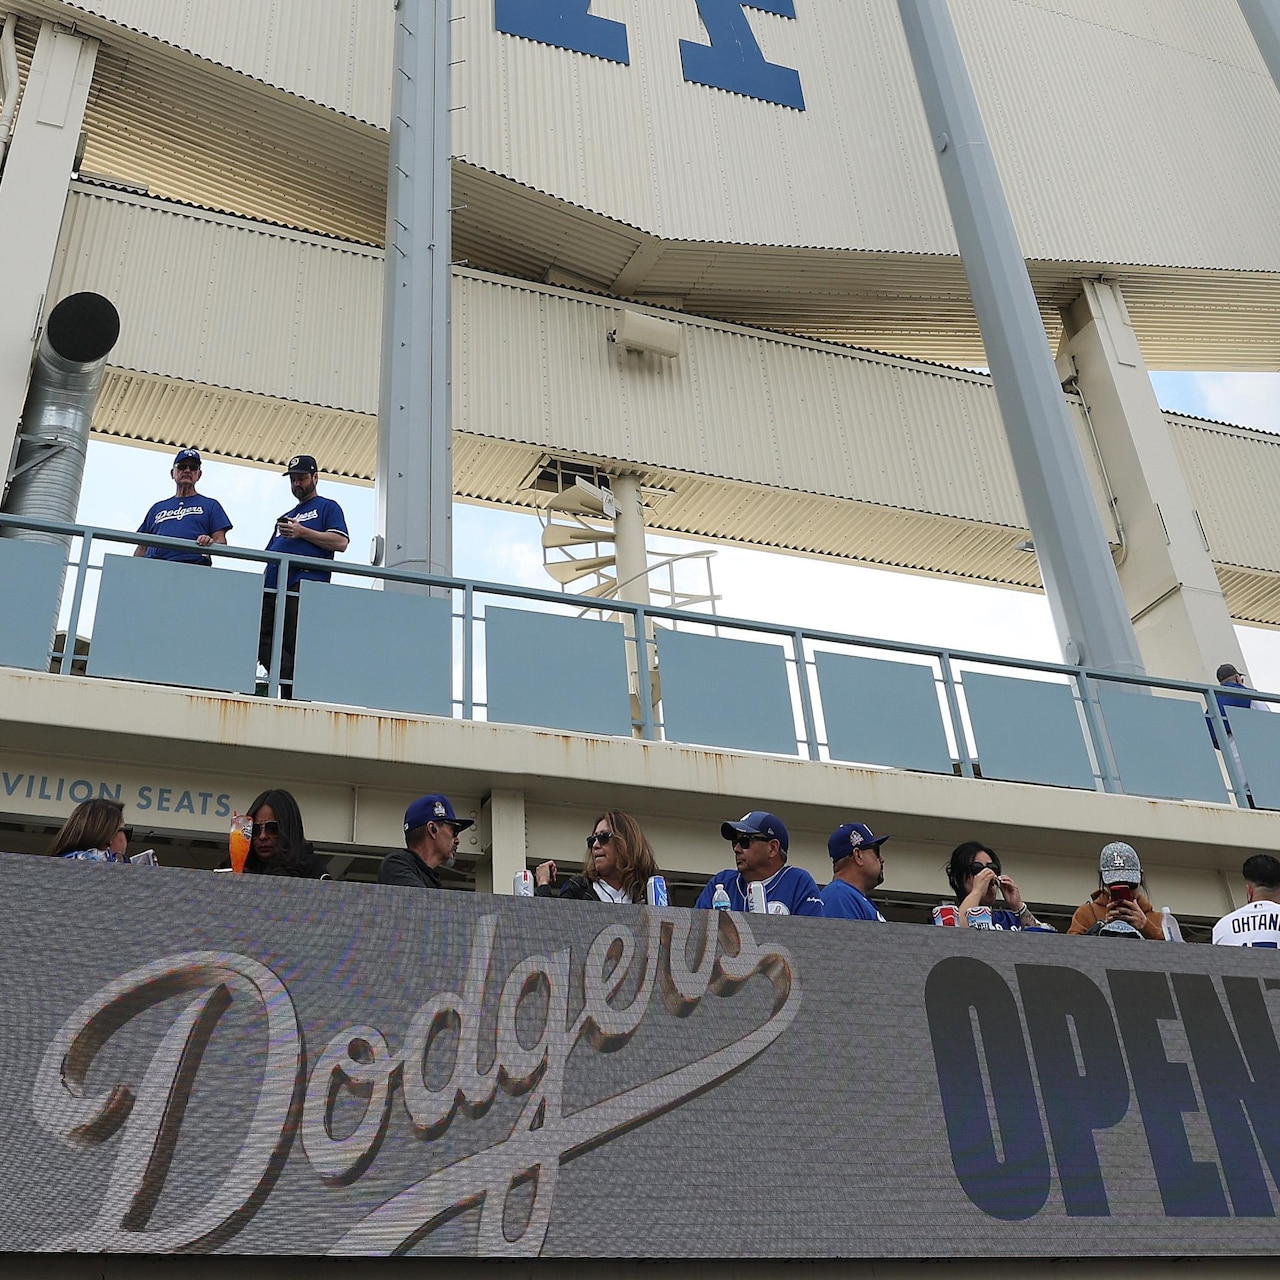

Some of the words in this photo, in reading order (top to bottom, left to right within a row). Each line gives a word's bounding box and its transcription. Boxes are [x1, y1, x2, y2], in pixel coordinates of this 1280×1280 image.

[155, 505, 204, 524] Dodgers
[137, 786, 231, 817] SEATS
[33, 911, 803, 1257] Dodgers
